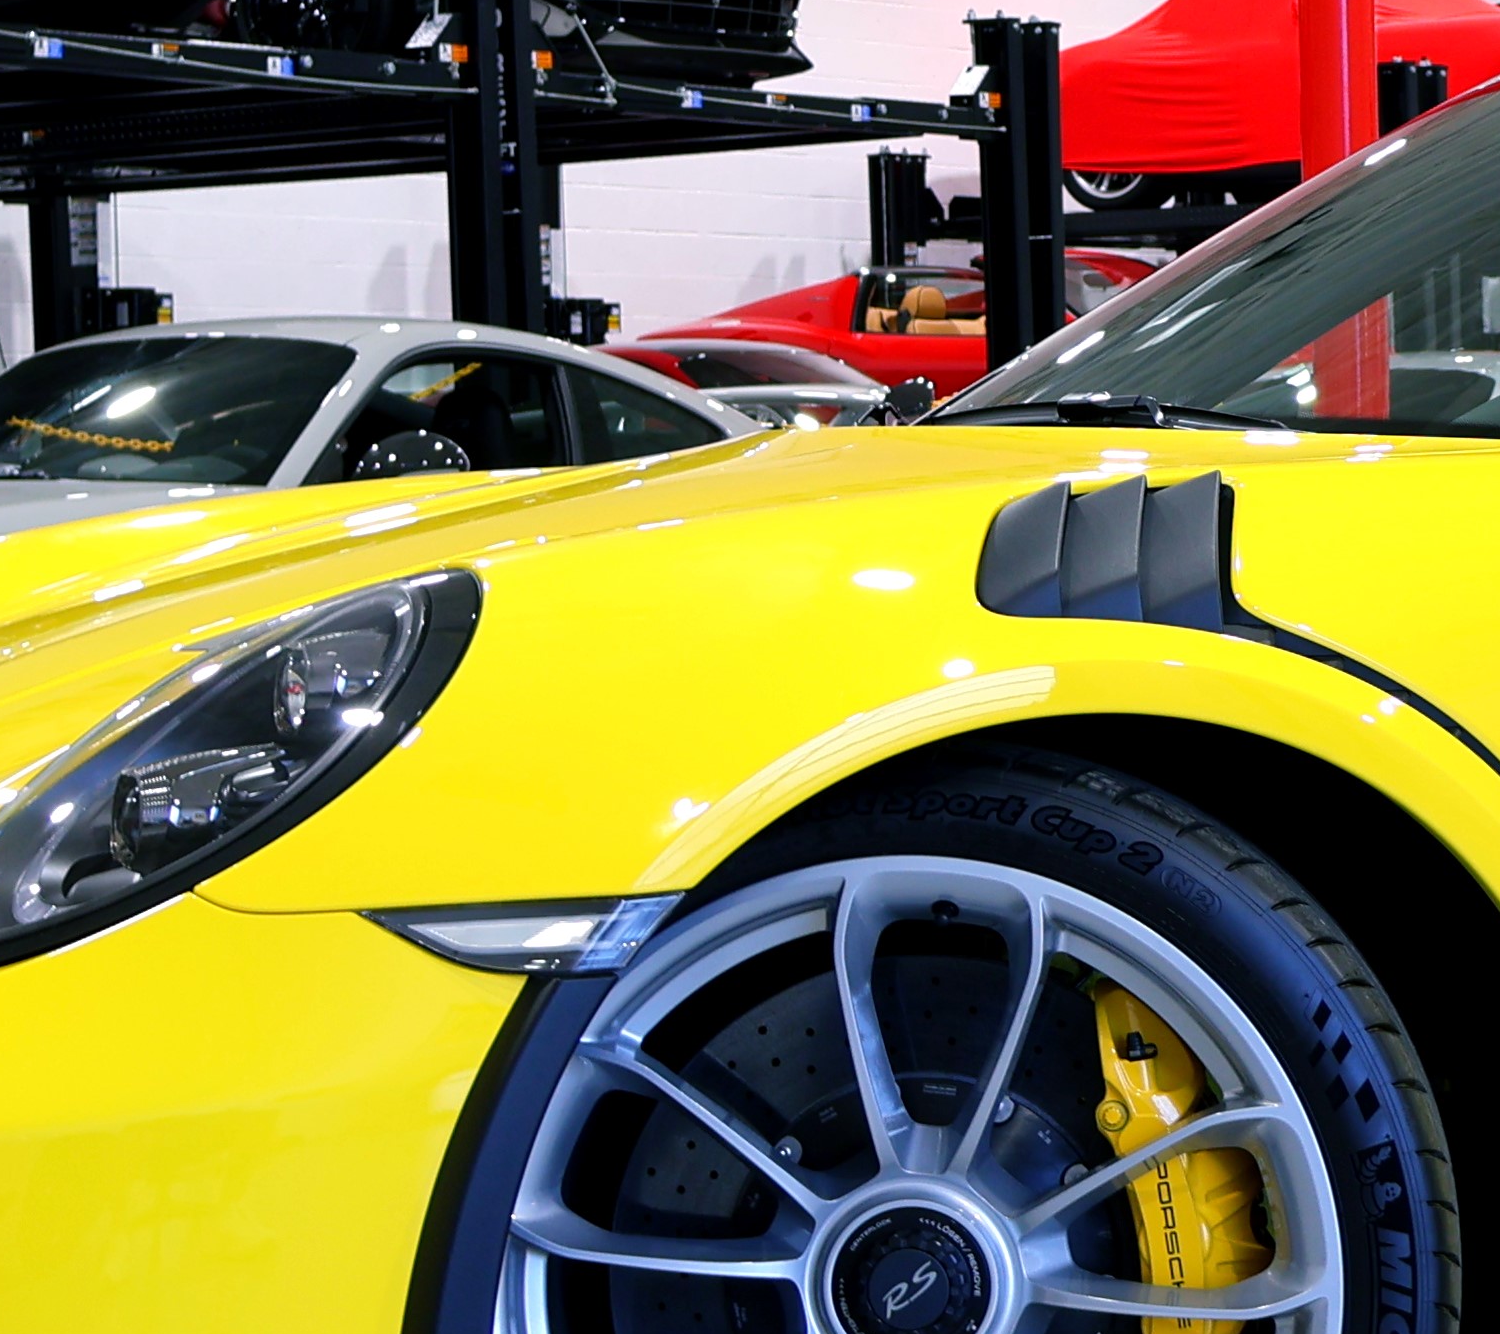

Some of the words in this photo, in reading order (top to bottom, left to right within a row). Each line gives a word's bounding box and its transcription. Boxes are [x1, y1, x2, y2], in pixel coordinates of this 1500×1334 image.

[1029, 803, 1118, 858] Cup
[1117, 840, 1165, 878] 2
[882, 1260, 938, 1320] RS
